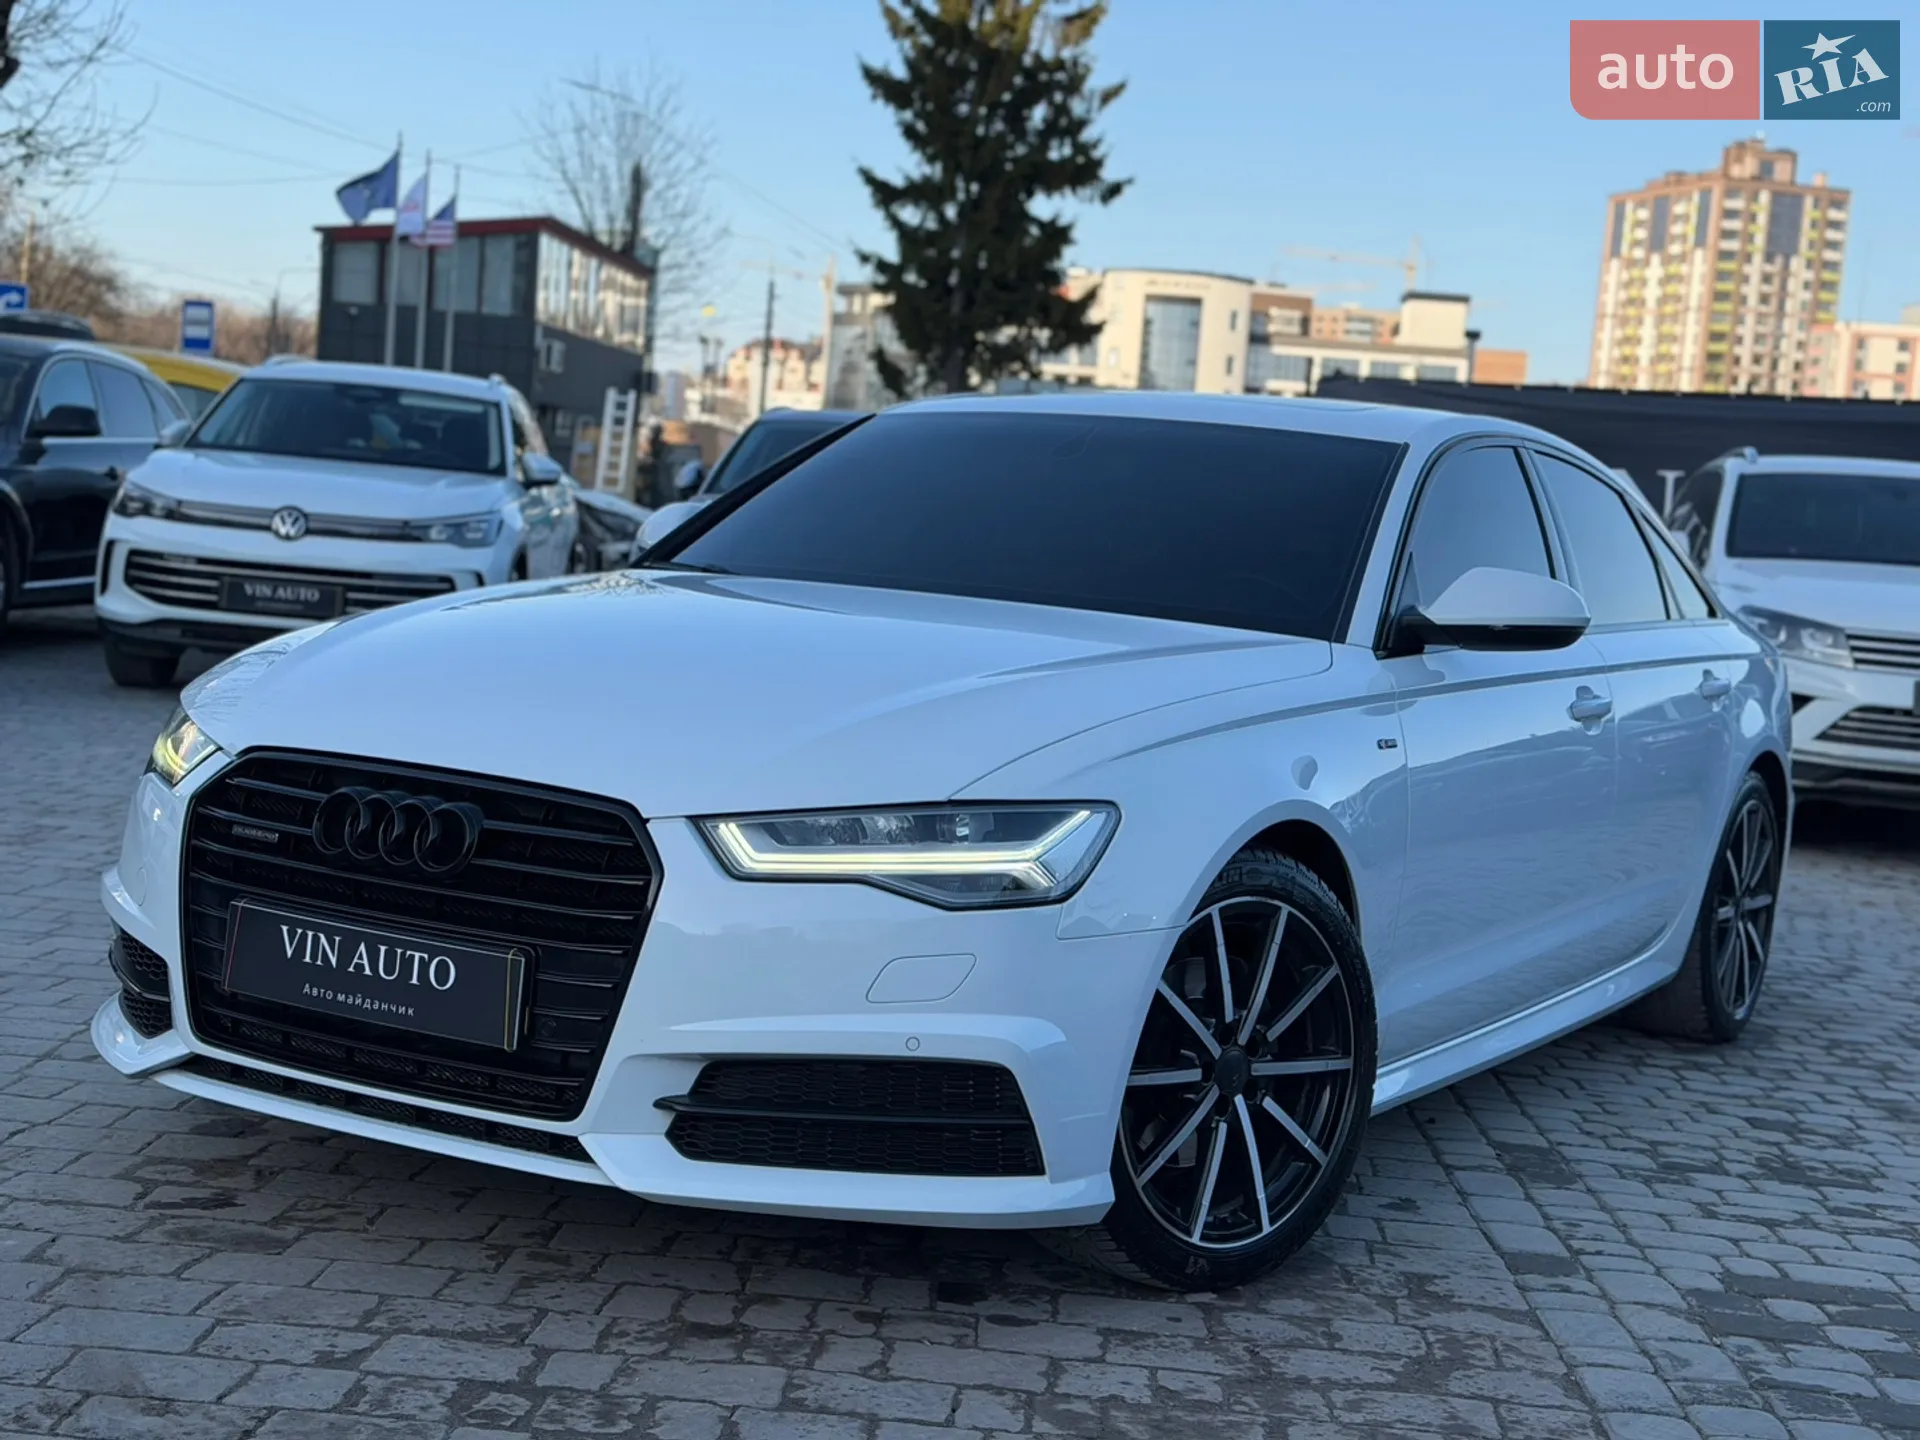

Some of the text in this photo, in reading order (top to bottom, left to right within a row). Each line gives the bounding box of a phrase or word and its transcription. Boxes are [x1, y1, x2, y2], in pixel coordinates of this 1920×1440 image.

[243, 582, 321, 602] VIN AUTO
[280, 924, 456, 991] VIN AUTO
